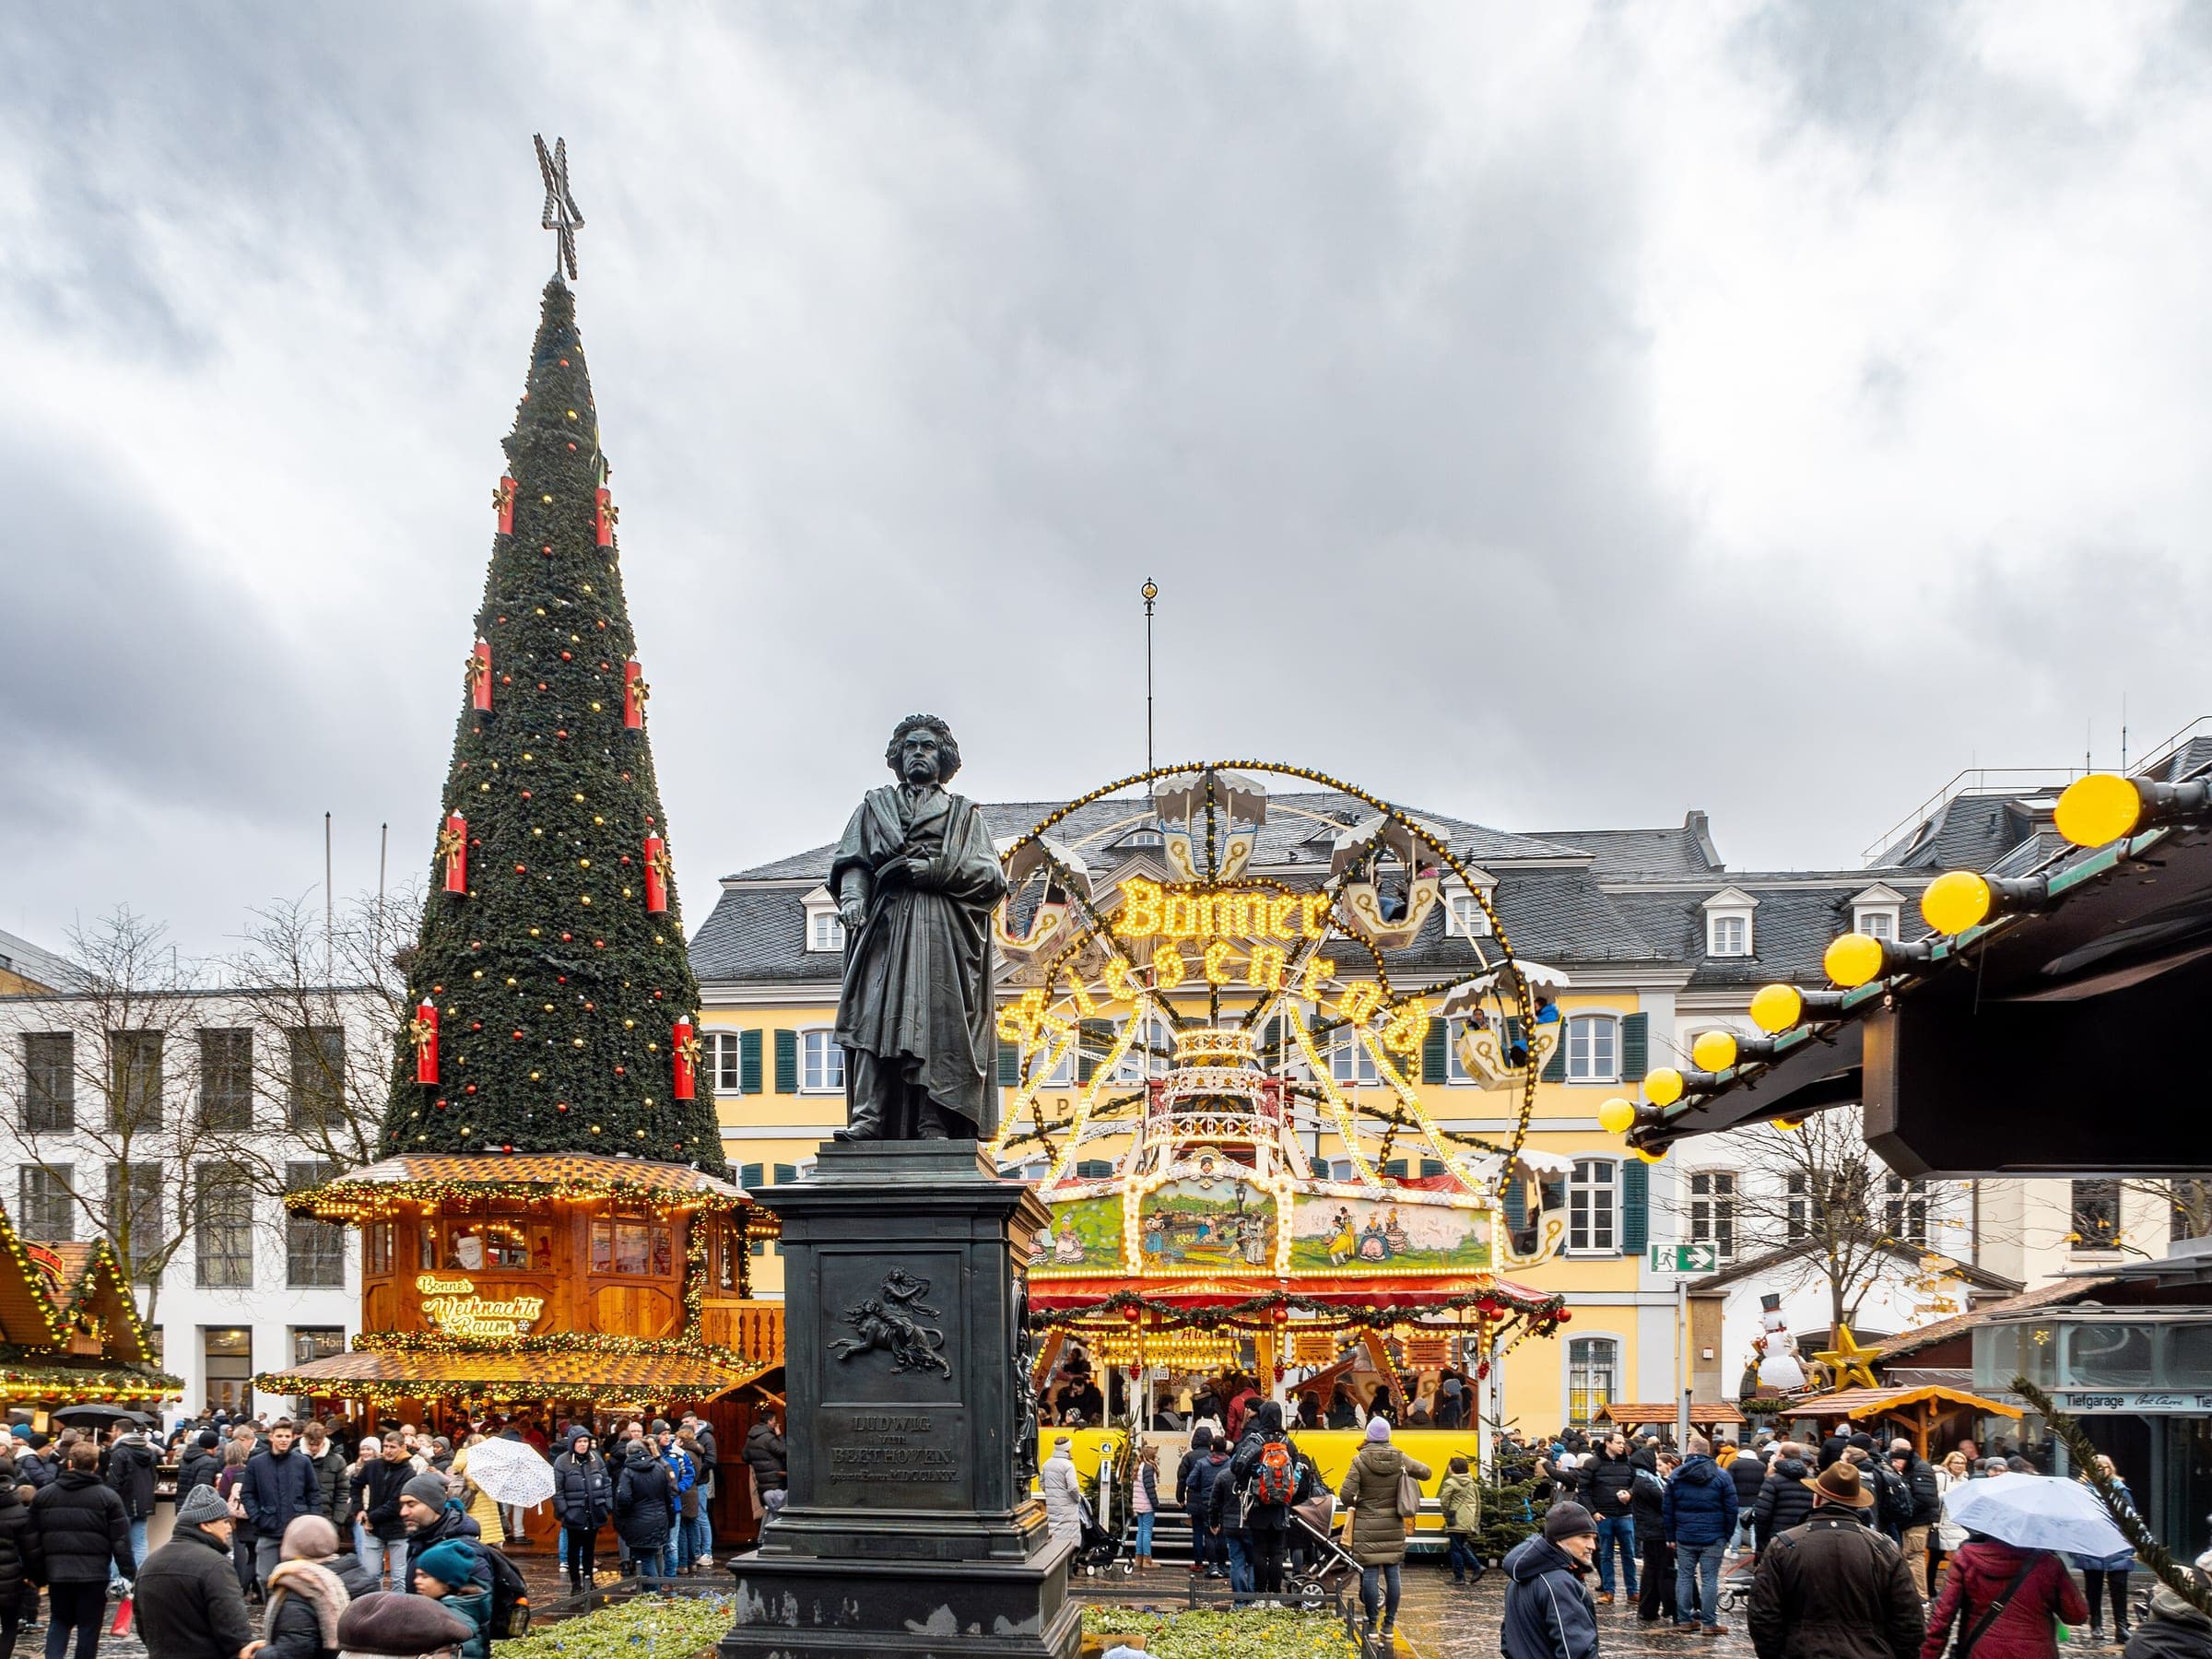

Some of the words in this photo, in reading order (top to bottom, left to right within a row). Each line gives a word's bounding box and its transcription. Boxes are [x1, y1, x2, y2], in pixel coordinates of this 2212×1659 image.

[1114, 877, 1329, 939] Bonner
[997, 943, 1430, 1054] Riesenrad
[418, 1277, 473, 1292] Bonner
[423, 1297, 544, 1319] Weihnachts
[452, 1317, 512, 1334] Baum
[2065, 1394, 2124, 1409] Tiefgarage
[853, 1416, 932, 1431] LUDWIG
